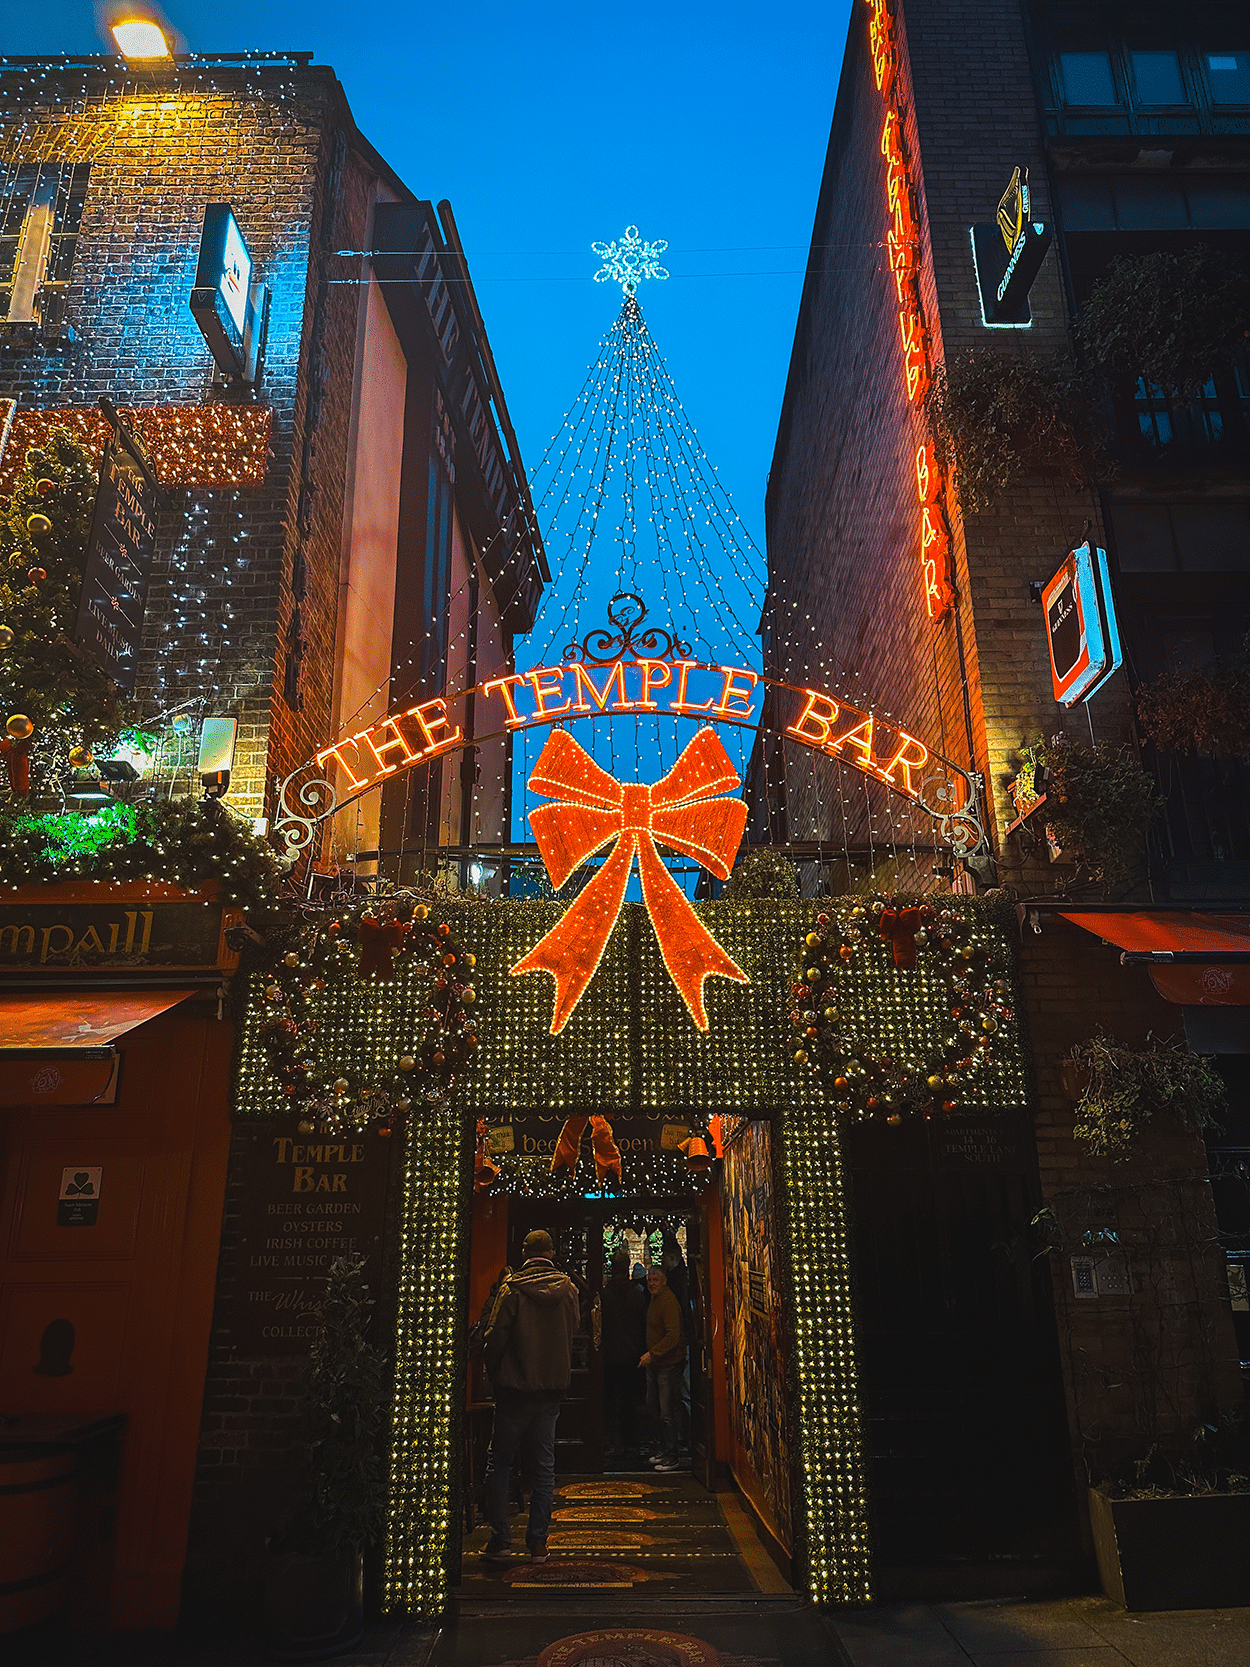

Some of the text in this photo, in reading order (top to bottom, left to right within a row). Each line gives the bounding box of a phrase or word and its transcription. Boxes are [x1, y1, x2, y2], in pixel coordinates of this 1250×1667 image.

[1021, 184, 1030, 213] GUINNESS
[998, 230, 1026, 301] GUINNESS
[414, 220, 461, 368] THE
[126, 467, 143, 497] THE
[108, 460, 155, 540] TEMPLE
[114, 497, 140, 550] BAR
[916, 443, 945, 619] BAR
[96, 538, 142, 606] BEER GARDEN
[88, 598, 109, 631] LIVE
[1051, 601, 1073, 633] GUINNESS
[316, 658, 928, 798] THE TEMPLE BAR
[272, 1136, 365, 1164] TEMPLE
[521, 1133, 560, 1153] bee
[945, 1144, 987, 1154] TEMPLE
[963, 1135, 974, 1145] 14
[964, 1154, 1001, 1163] SOUTH
[292, 1166, 348, 1193] BAR
[267, 1202, 361, 1215] BEER GARDEN
[282, 1221, 343, 1233] OYSTERS
[266, 1237, 357, 1250] IRISH COFFEE
[249, 1255, 280, 1267] LIVE
[284, 1255, 328, 1267] MUSIC
[248, 1291, 272, 1302] THE
[261, 1325, 321, 1338] COLLECT
[571, 1632, 677, 1646] TEMPLE
